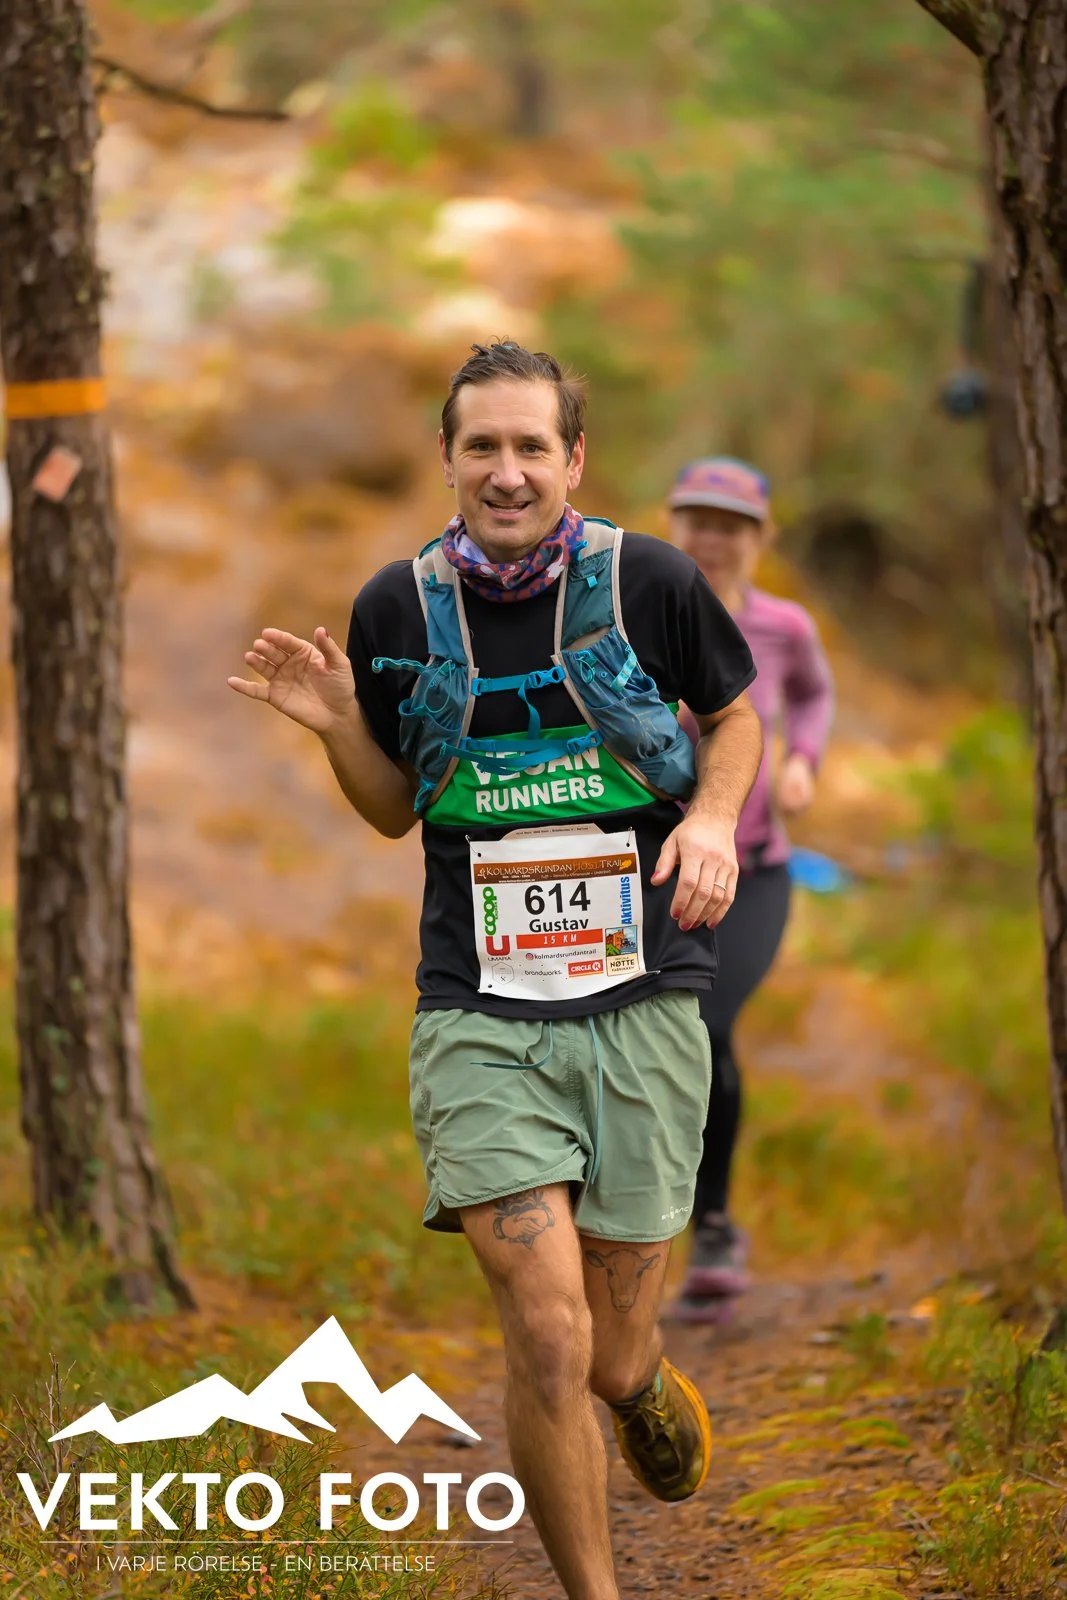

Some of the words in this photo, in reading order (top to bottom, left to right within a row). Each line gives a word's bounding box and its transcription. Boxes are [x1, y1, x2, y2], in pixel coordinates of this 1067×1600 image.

[475, 774, 605, 814] RUNNERS
[524, 881, 591, 915] 614
[620, 876, 632, 925] Aktivitus
[482, 886, 497, 936] coop
[529, 918, 589, 933] Gustav
[543, 935, 556, 944] 15
[563, 933, 577, 943] KM
[534, 949, 597, 960] kolmardsrundantrail
[570, 964, 591, 973] CIRCLE
[592, 962, 601, 971] K
